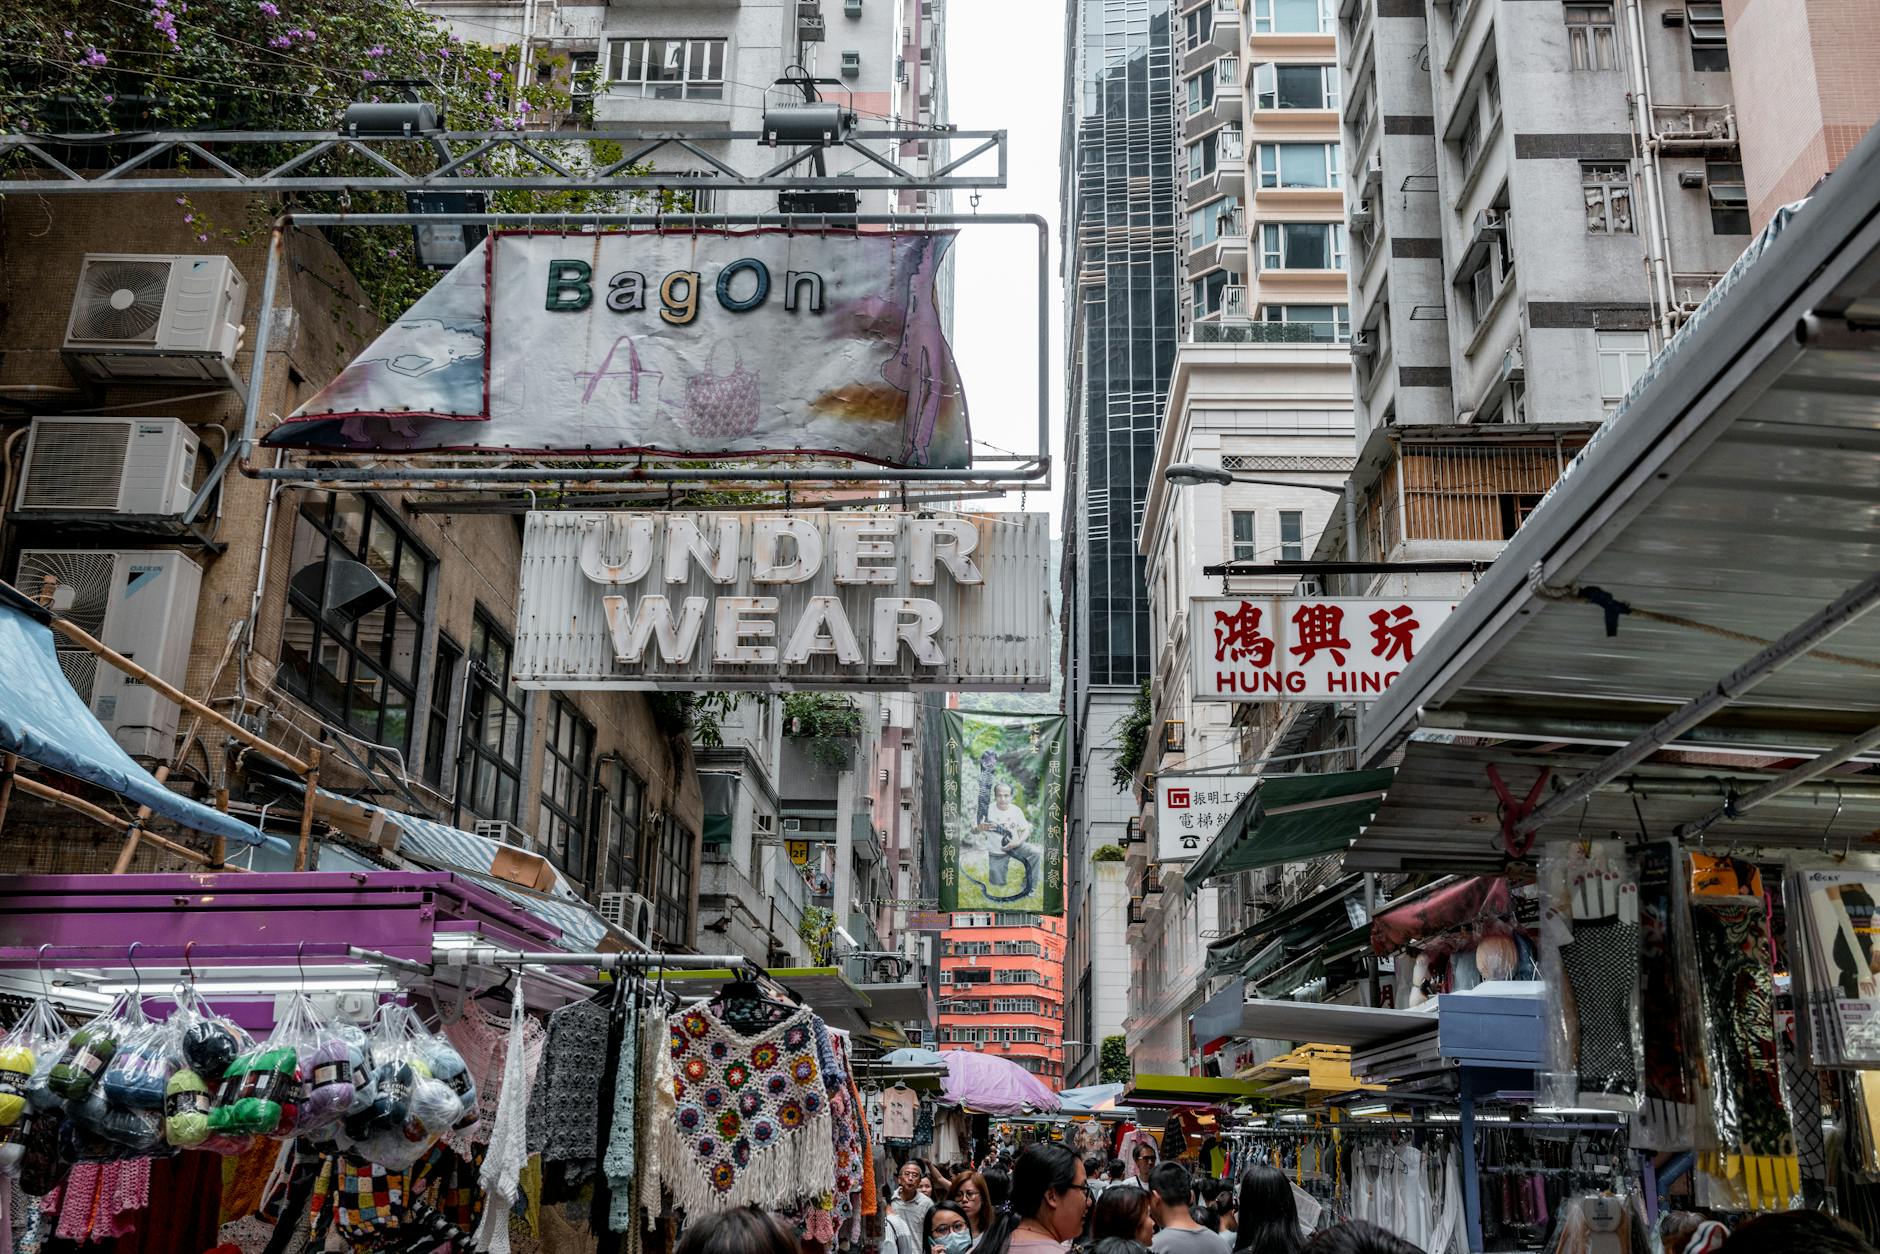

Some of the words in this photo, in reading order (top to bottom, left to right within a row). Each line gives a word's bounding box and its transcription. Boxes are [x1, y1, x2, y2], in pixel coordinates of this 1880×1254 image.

[579, 516, 985, 585] UNDER
[602, 594, 947, 665] WEAR
[1214, 600, 1457, 669] 鴻興玩
[1217, 671, 1307, 693] HUNG
[792, 849, 806, 858] 2F
